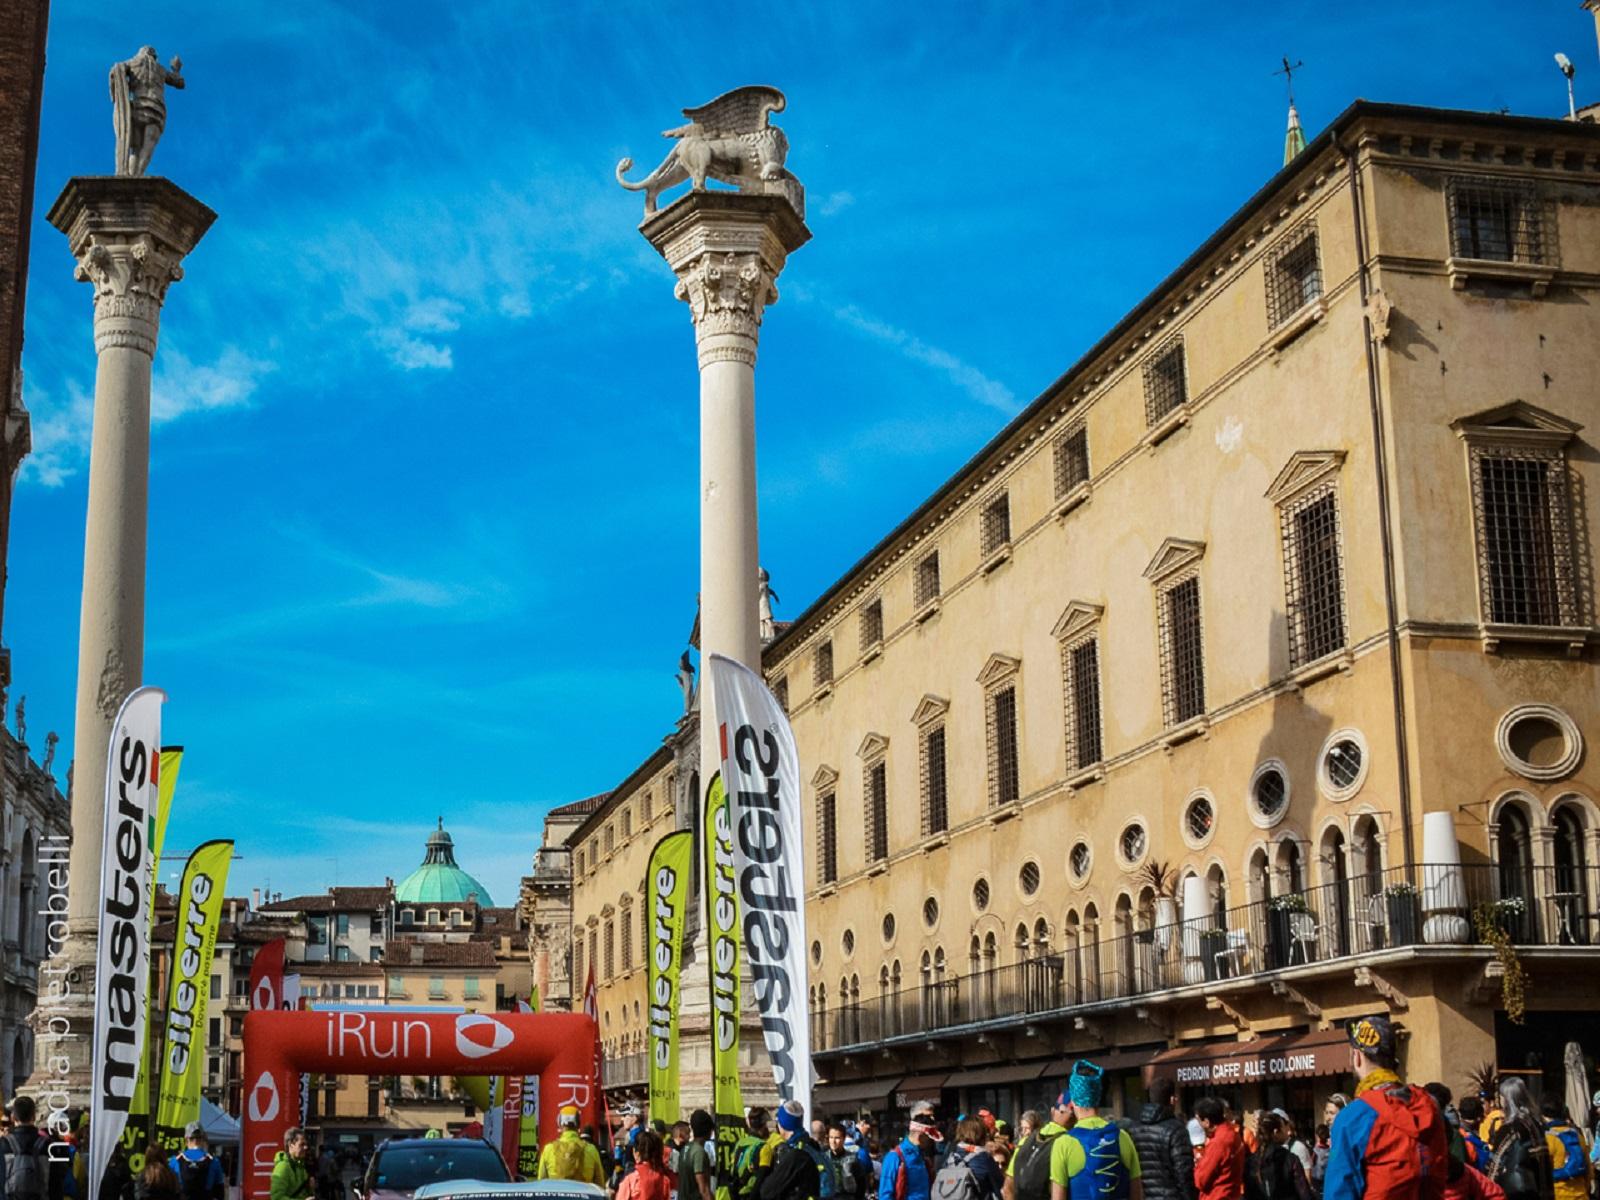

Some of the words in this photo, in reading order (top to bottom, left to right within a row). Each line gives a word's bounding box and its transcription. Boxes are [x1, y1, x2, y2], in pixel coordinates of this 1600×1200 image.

[103, 736, 147, 1112] masters
[169, 873, 213, 1075] elleerre
[195, 1000, 206, 1028] Dove
[204, 924, 215, 976] passione
[651, 866, 677, 1070] elleerre
[327, 1012, 432, 1059] iRun
[1177, 1066, 1210, 1082] PEDRON
[1244, 1060, 1266, 1076] ALLE
[1269, 1054, 1316, 1073] COLONNE
